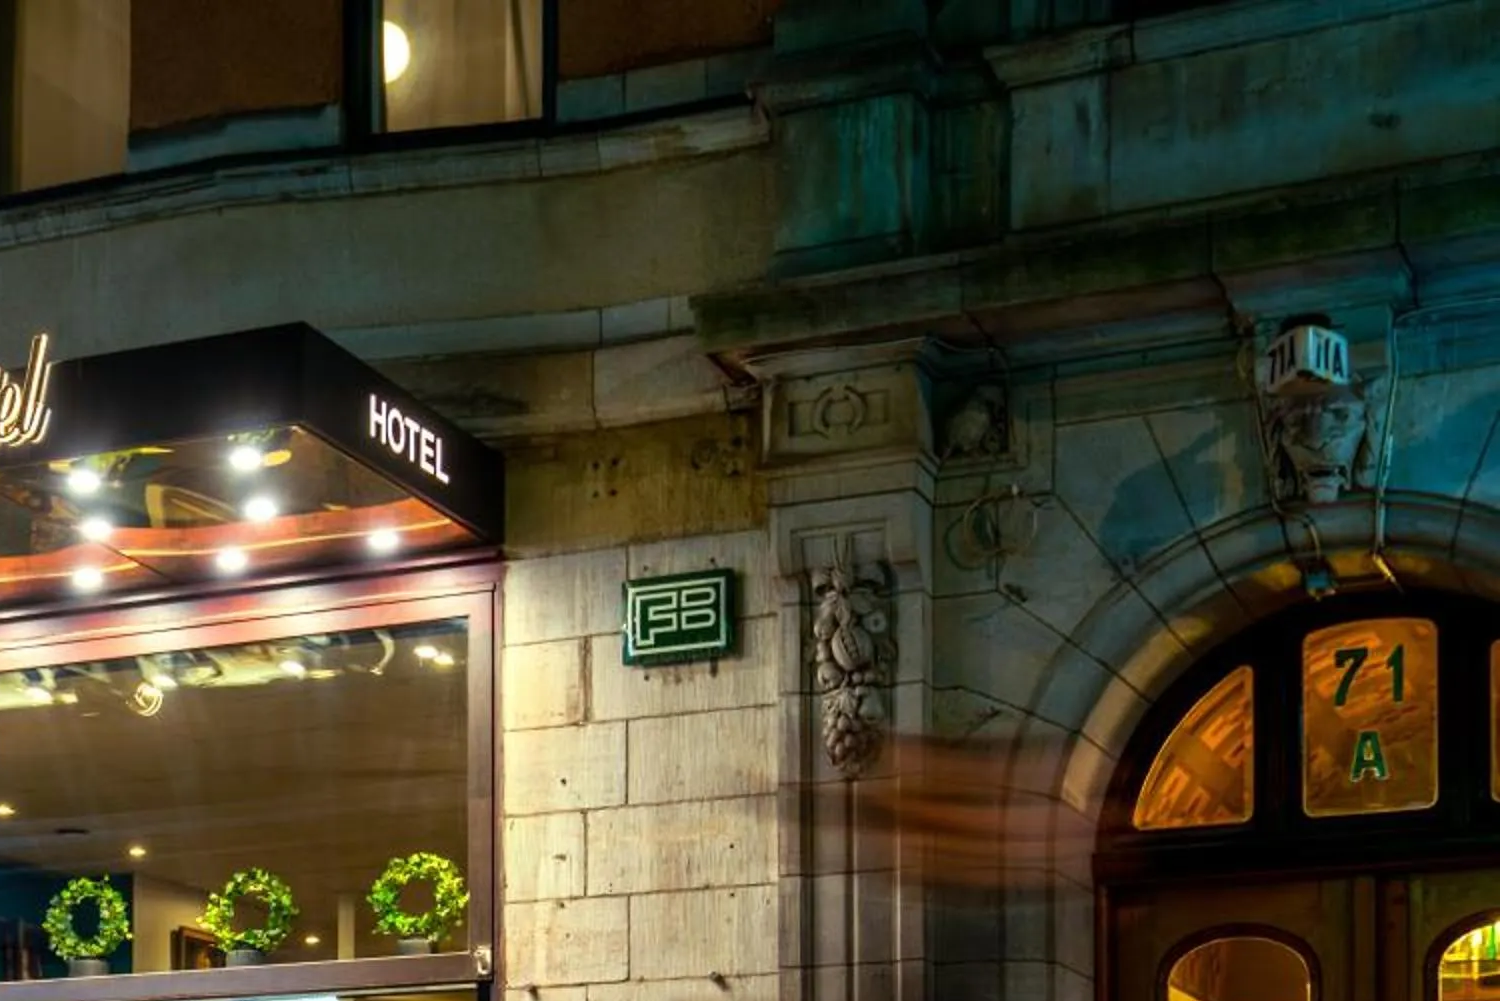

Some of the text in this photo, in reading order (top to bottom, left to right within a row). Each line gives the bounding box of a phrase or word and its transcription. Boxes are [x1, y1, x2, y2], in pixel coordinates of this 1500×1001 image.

[369, 393, 450, 485] HOTEL
[1333, 645, 1404, 707] 71
[1351, 730, 1390, 782] A
